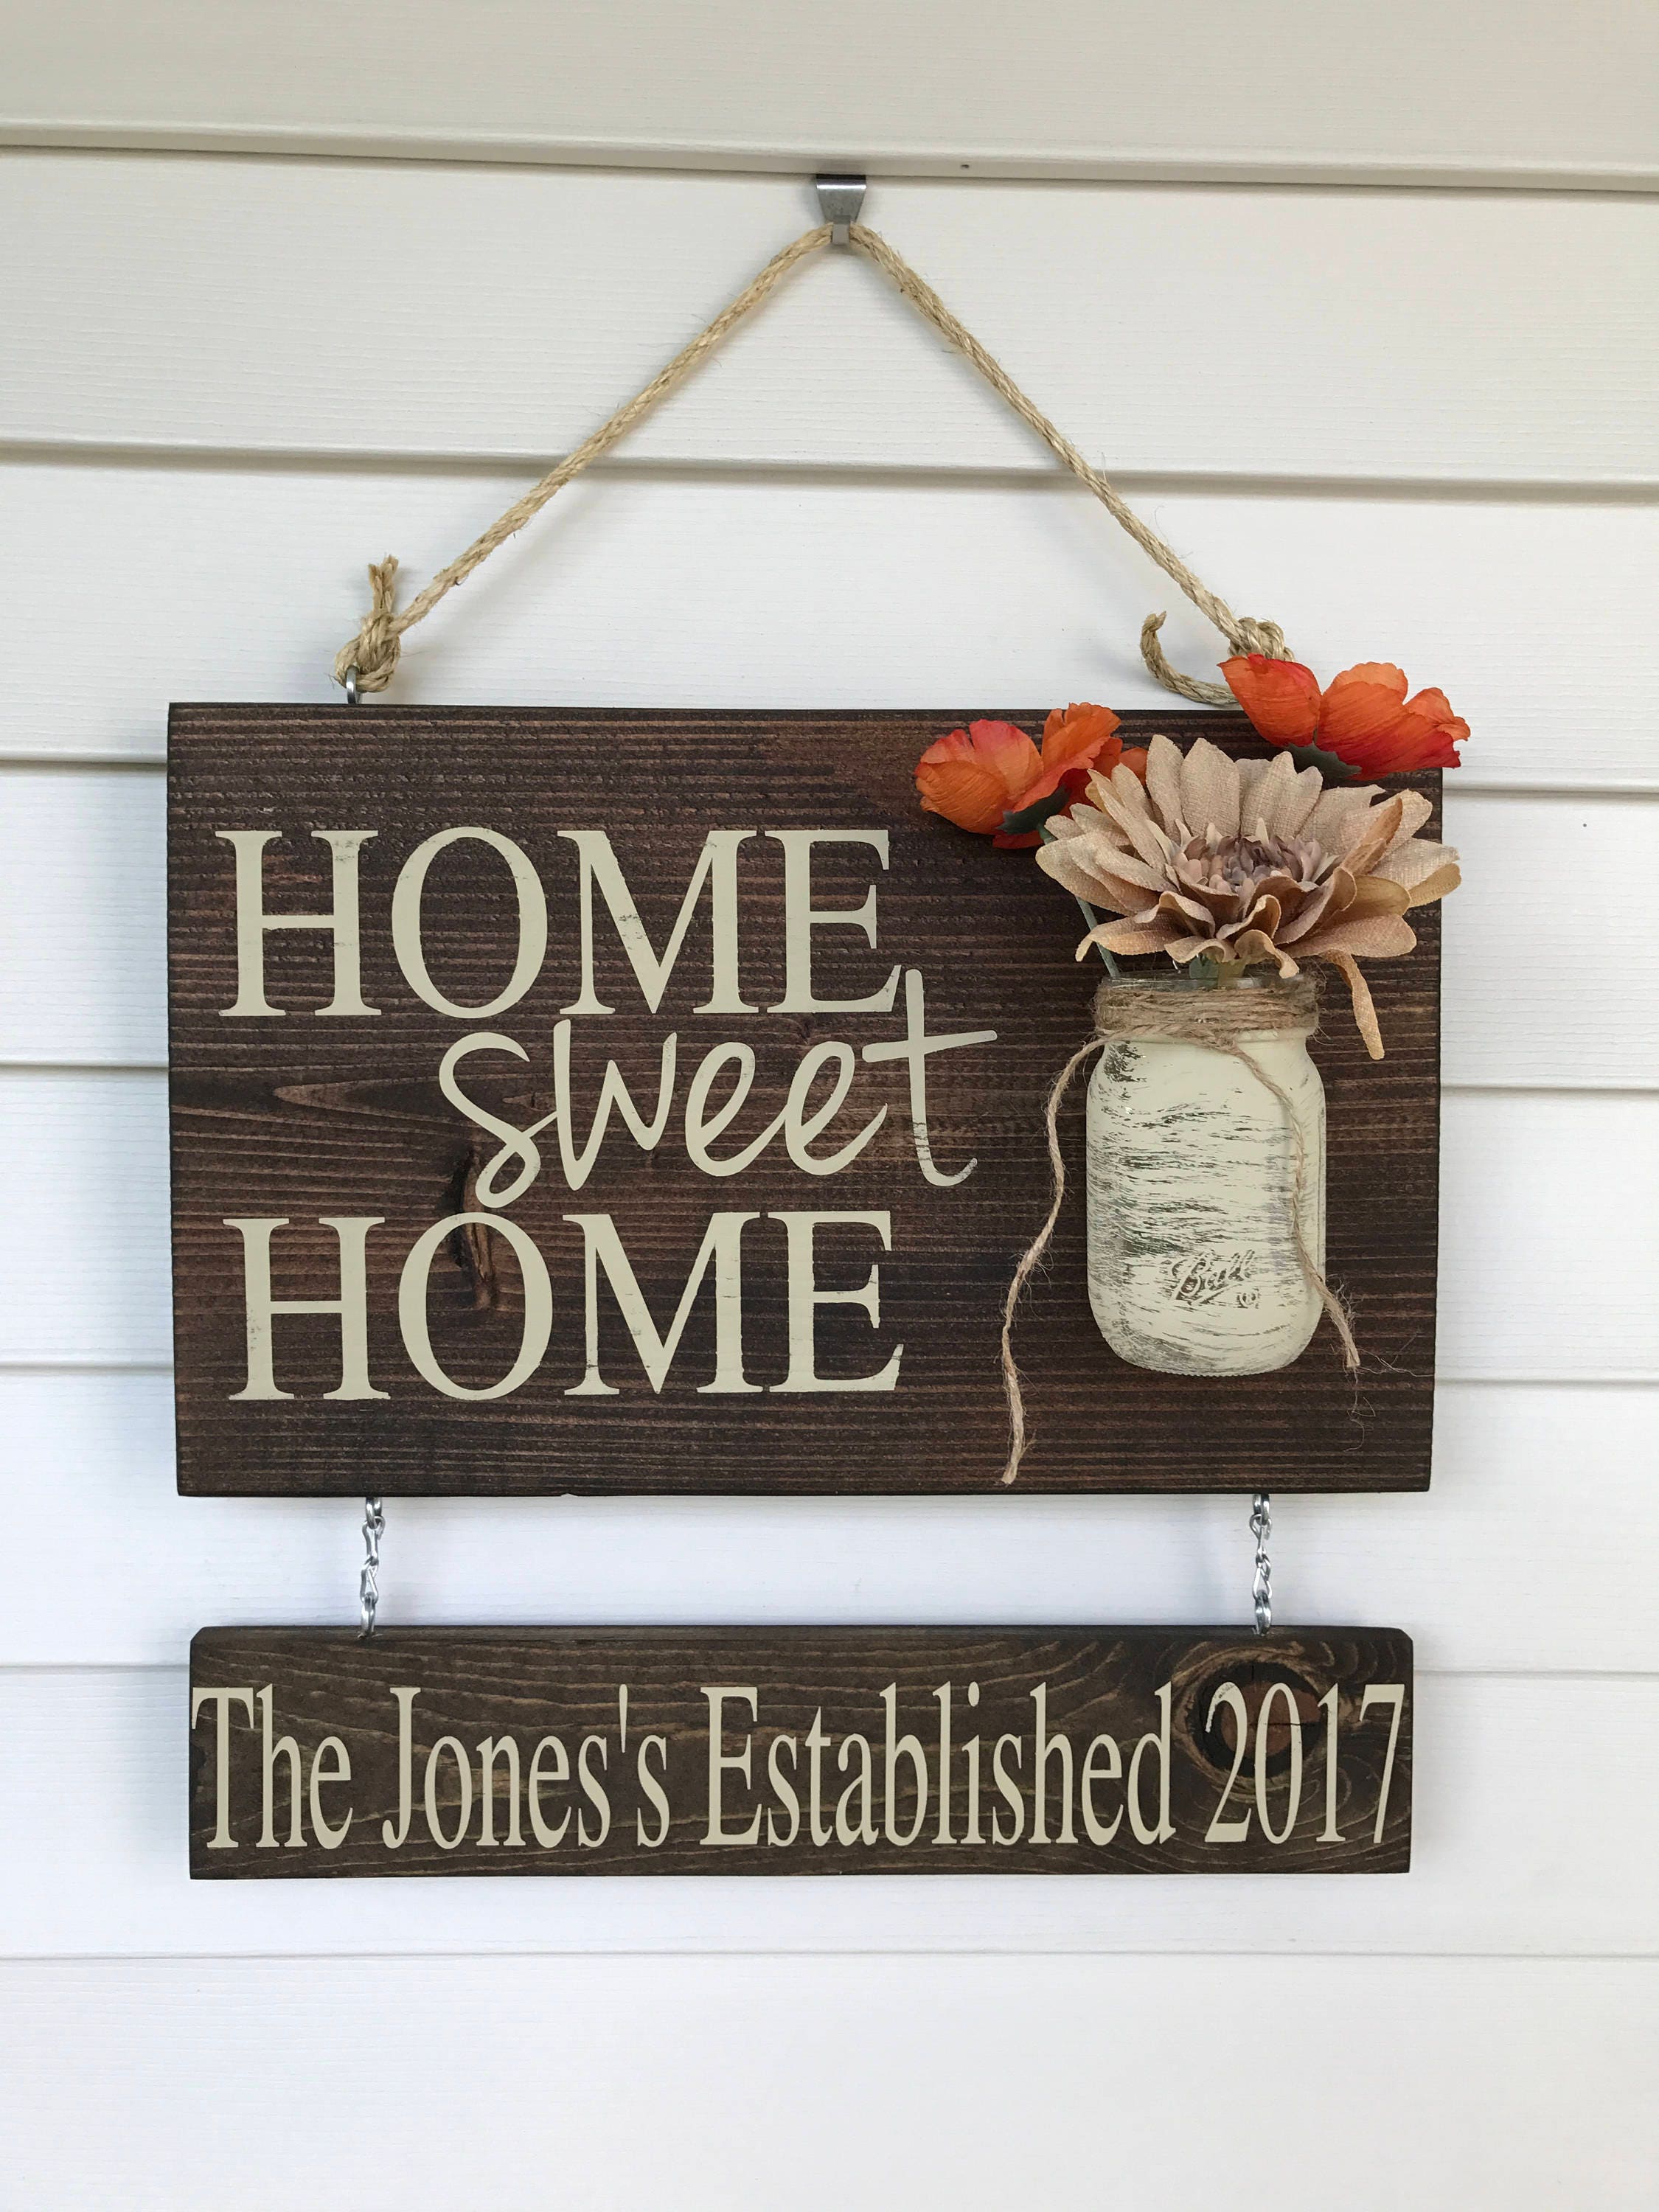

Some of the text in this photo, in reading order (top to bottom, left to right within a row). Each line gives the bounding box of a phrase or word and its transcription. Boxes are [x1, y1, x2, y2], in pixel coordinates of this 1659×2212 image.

[215, 826, 902, 1019] HOME
[439, 969, 998, 1208] sweet
[223, 1210, 904, 1401] HOME
[192, 1680, 1405, 1849] The Jones's Established 2017
